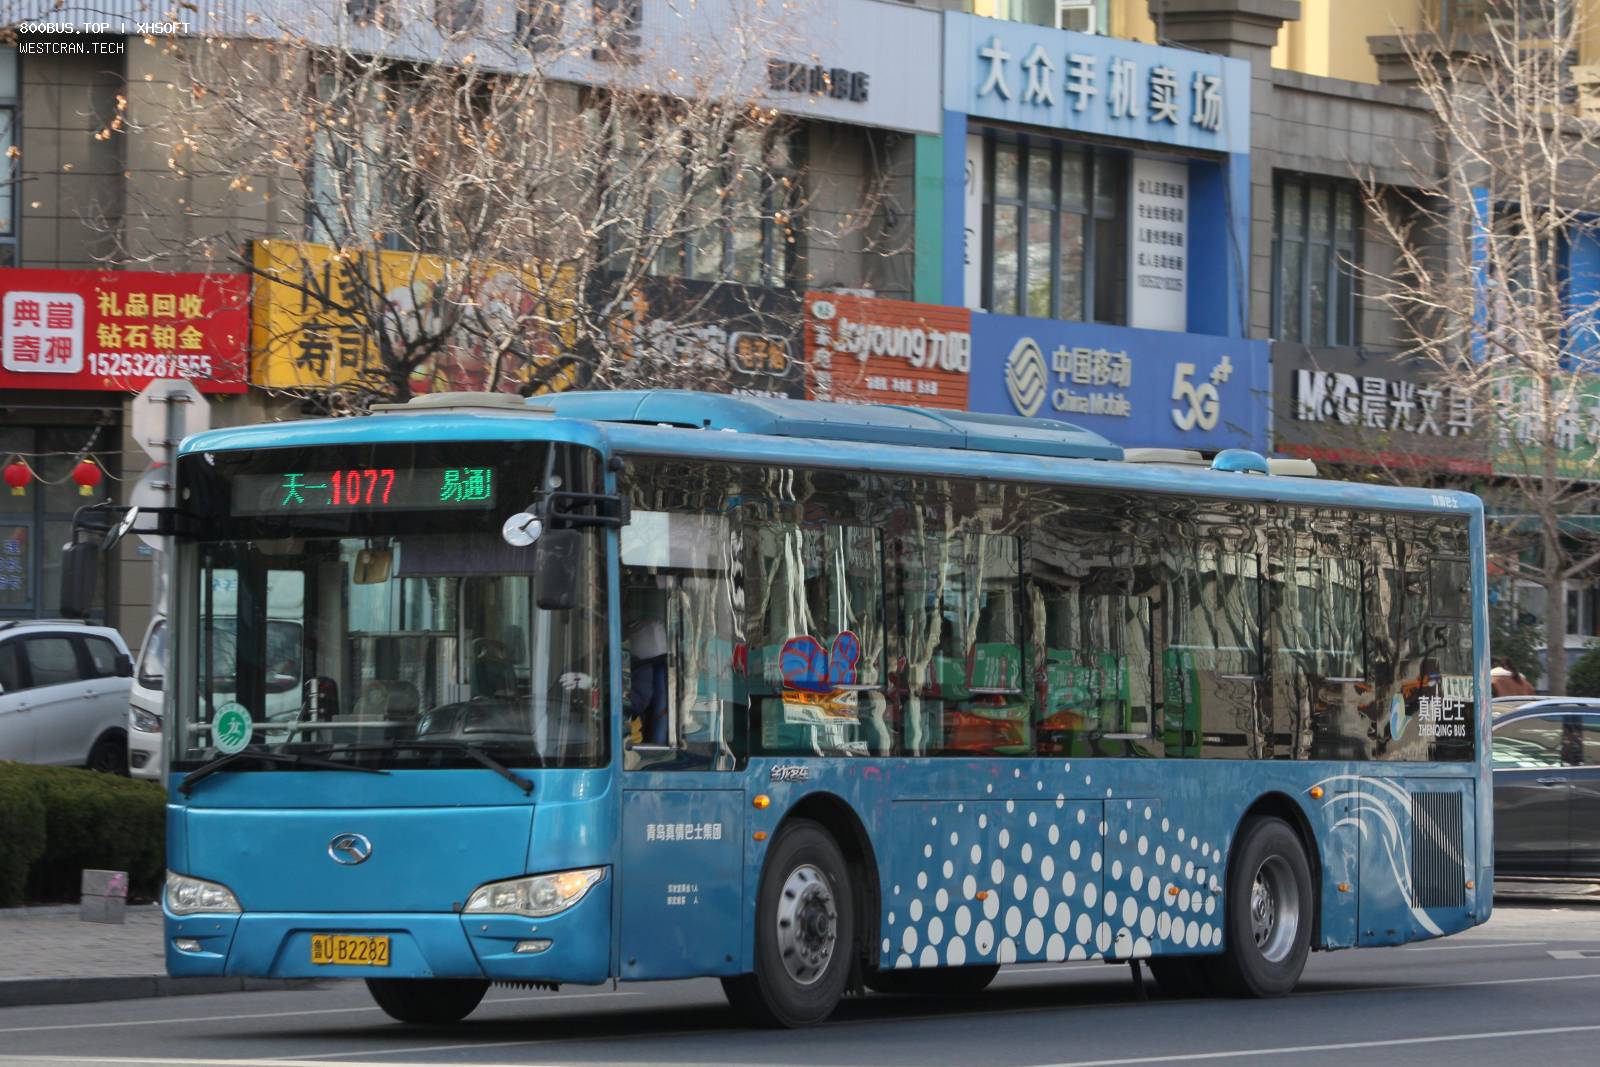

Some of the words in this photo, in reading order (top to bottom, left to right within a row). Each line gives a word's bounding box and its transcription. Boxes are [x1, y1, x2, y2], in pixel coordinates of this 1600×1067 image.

[977, 37, 1223, 132] 大众手机卖场
[97, 292, 204, 318] 礼品回收
[97, 324, 204, 350] 钻石铂金
[296, 316, 369, 379] 寿司
[1052, 345, 1132, 388] 中国移动
[1052, 388, 1090, 415] China
[1090, 392, 1132, 417] Mobile
[1361, 376, 1473, 437] 晨光文具
[331, 469, 396, 505] 1077
[1418, 695, 1465, 721] 真情巴士
[1418, 723, 1453, 738] ZHENQING
[1454, 723, 1466, 737] BUS
[646, 823, 722, 841] 青岛真情巴士集团
